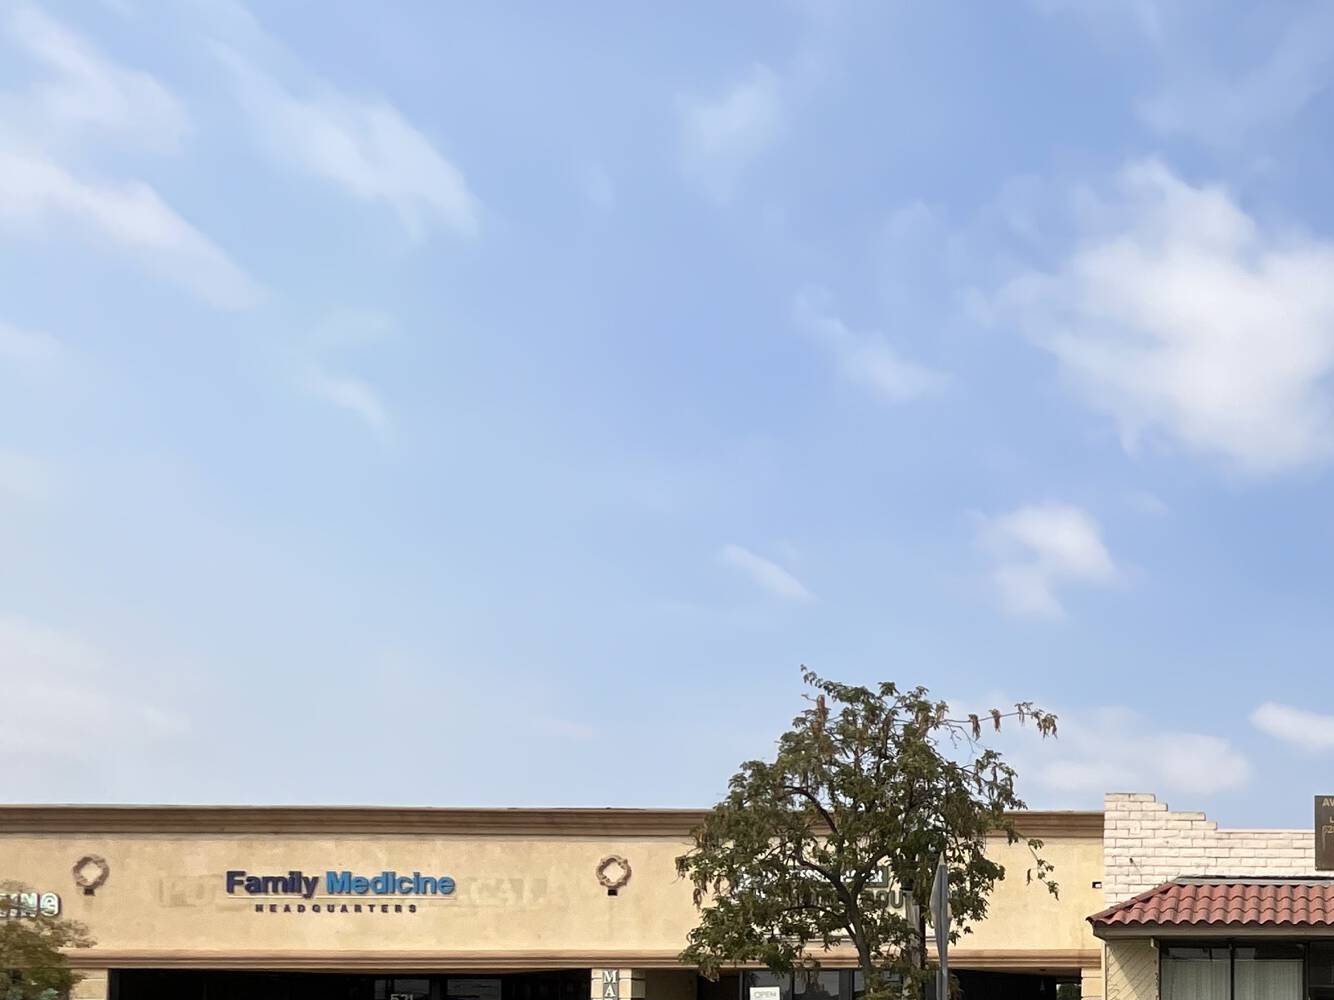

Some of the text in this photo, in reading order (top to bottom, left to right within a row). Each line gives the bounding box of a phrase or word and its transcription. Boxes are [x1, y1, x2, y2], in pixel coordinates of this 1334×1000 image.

[226, 871, 319, 898] Family
[326, 871, 456, 894] Medicine
[255, 904, 417, 913] HEADQUARTERS
